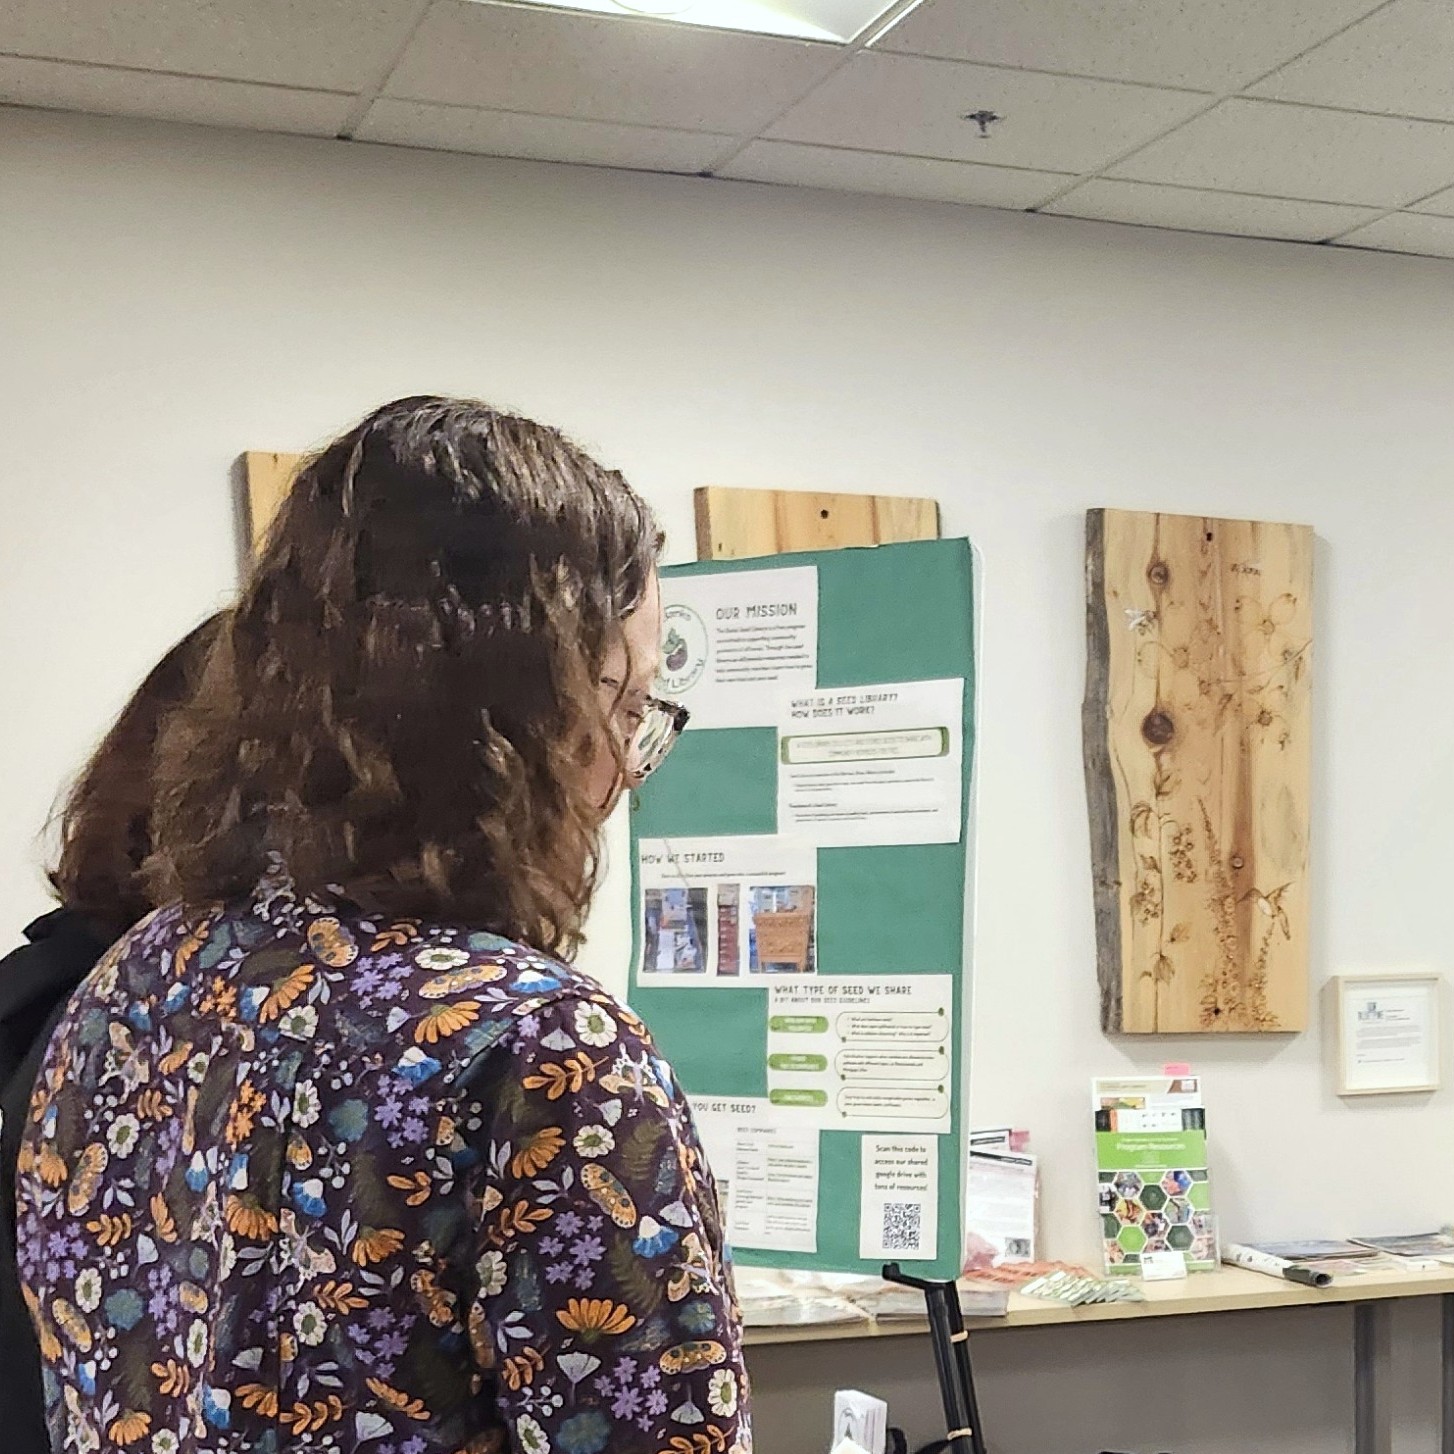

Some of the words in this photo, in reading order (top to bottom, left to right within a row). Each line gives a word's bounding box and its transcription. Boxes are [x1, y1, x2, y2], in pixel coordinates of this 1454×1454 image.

[716, 607, 739, 620] OUR
[746, 603, 797, 618] MISSION
[641, 854, 663, 865] HOW
[667, 854, 680, 864] WE
[683, 852, 725, 863] STARTED
[775, 986, 800, 995] WHAT
[803, 986, 825, 995] TYPE
[828, 986, 839, 995] OF
[842, 986, 865, 995] SEED
[868, 986, 882, 995] WE
[884, 986, 912, 995] SHARE
[692, 1102, 709, 1113] YOU
[712, 1103, 729, 1114] GET
[730, 1104, 758, 1115] SEED?
